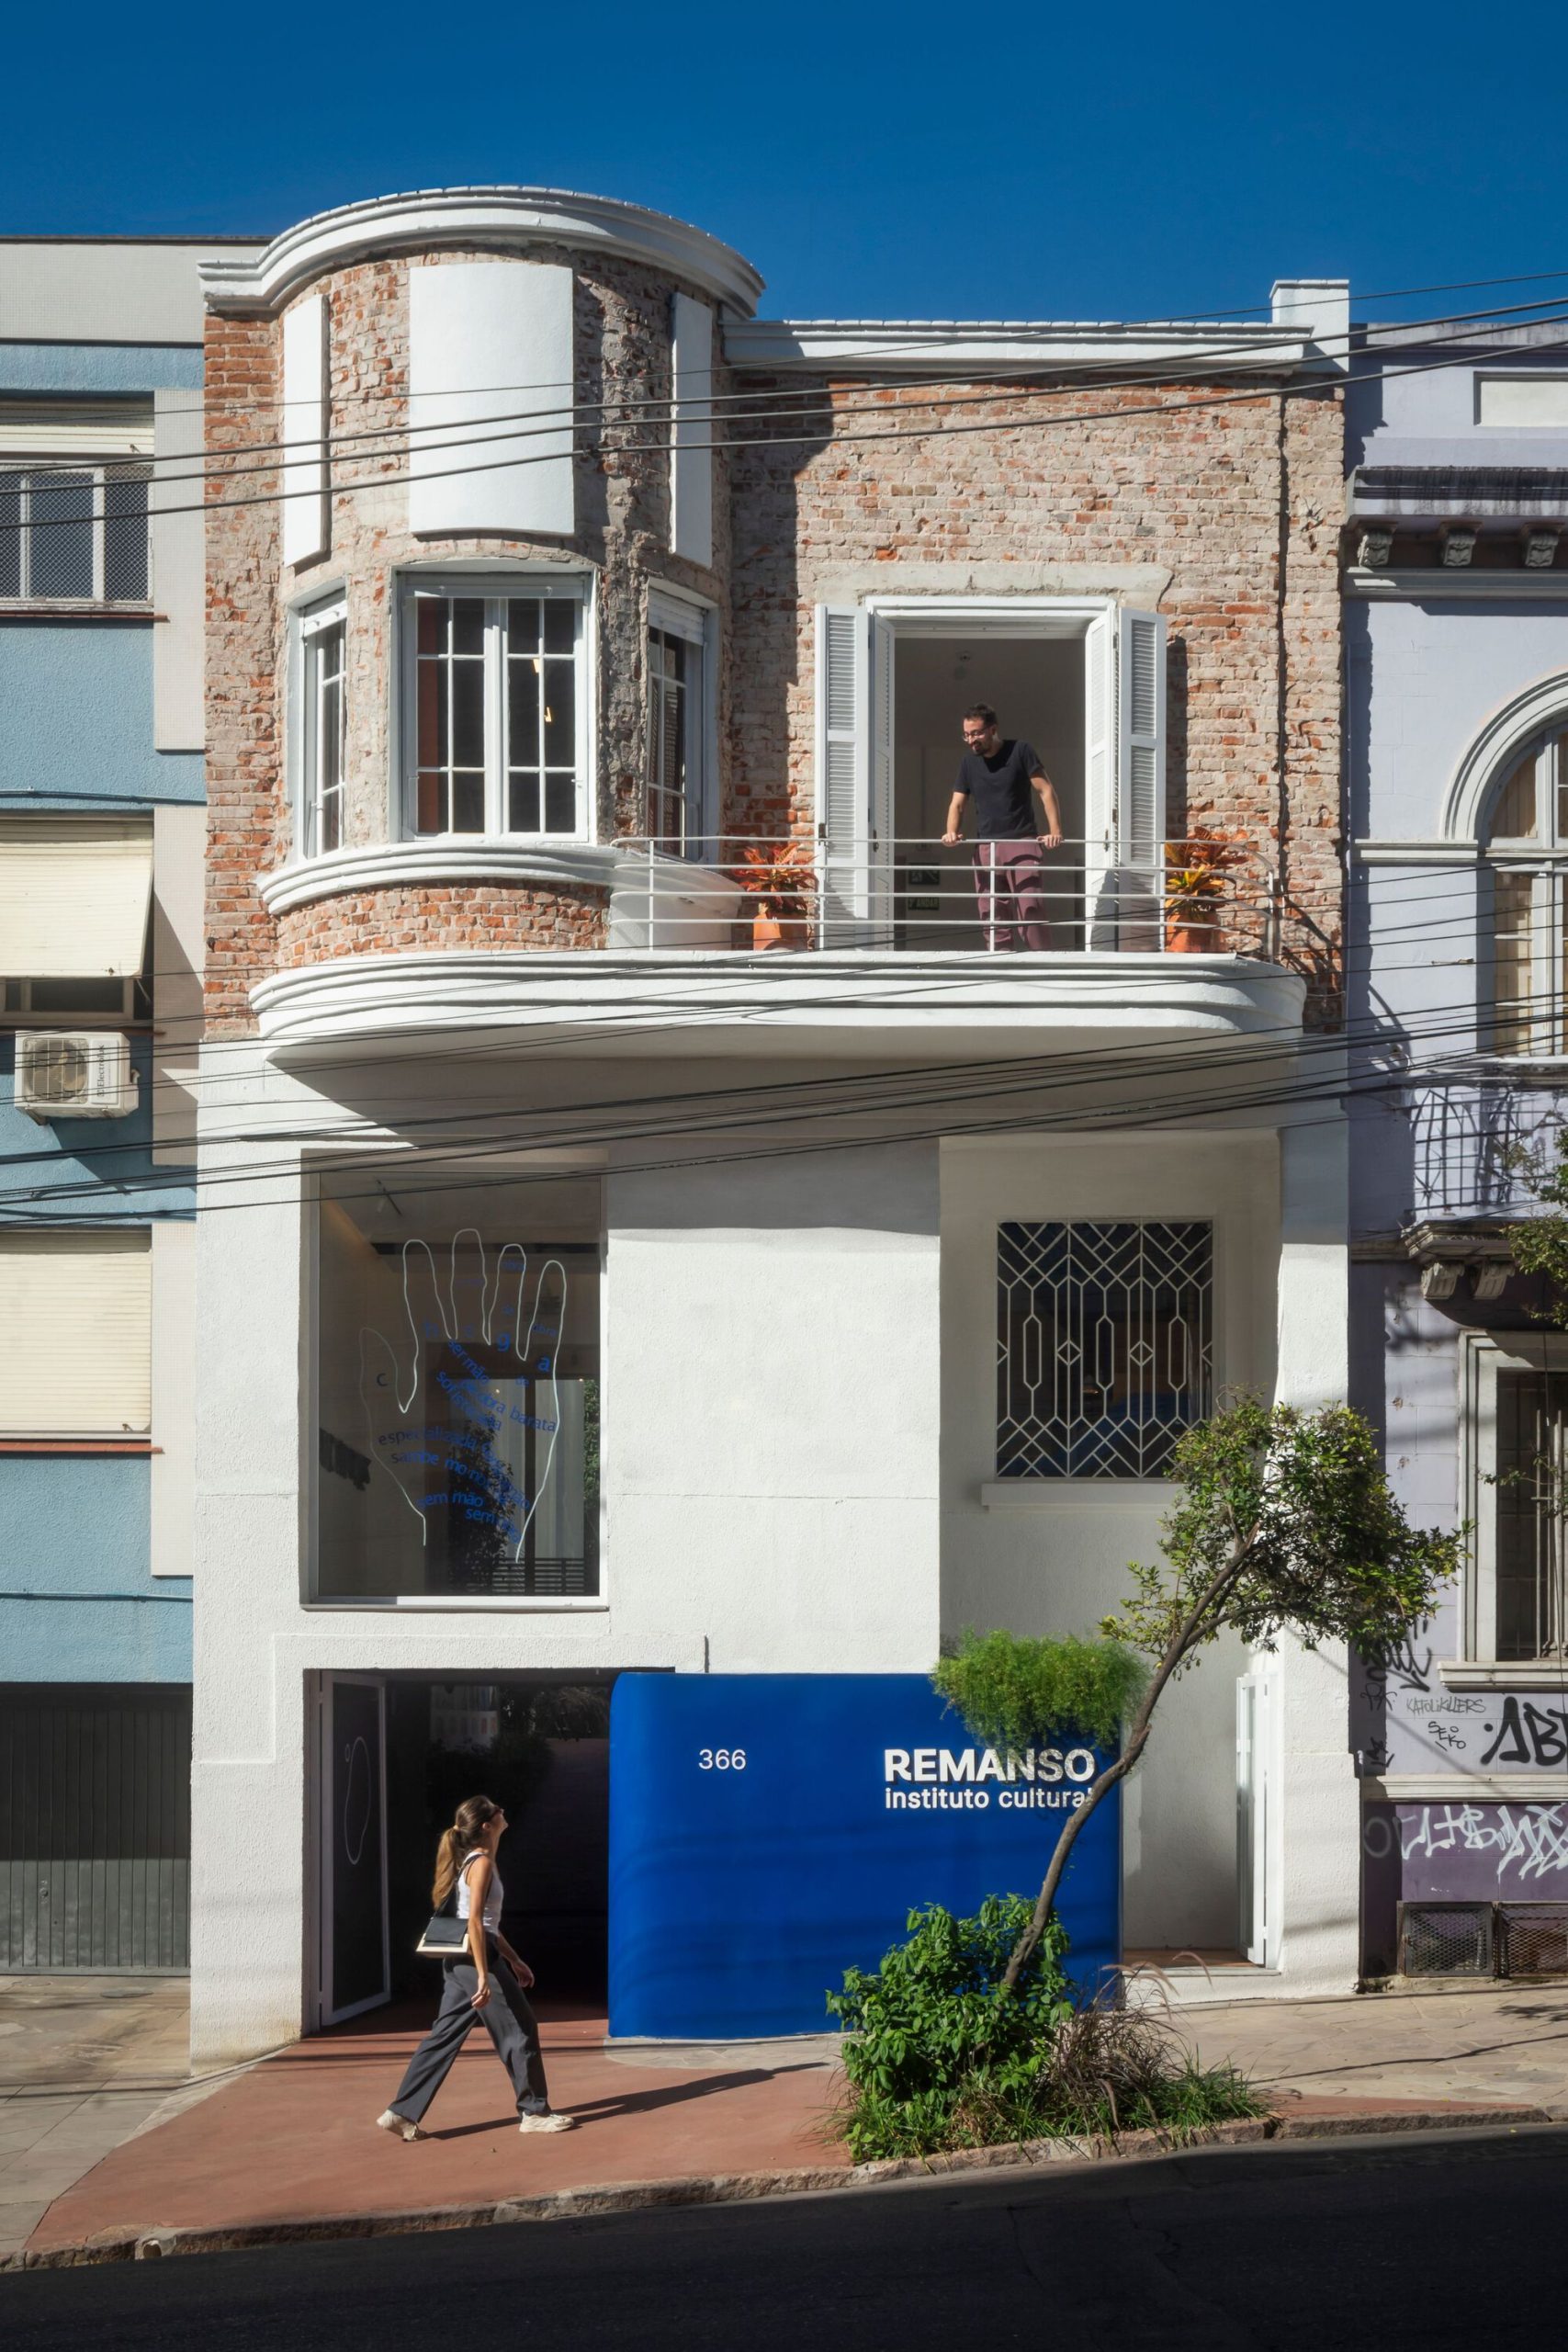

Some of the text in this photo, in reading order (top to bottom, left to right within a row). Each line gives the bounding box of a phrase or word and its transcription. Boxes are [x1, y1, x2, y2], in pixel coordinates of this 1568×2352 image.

[698, 1748, 747, 1770] 366
[884, 1747, 1096, 1782] REMANSO
[885, 1787, 989, 1809] instituto
